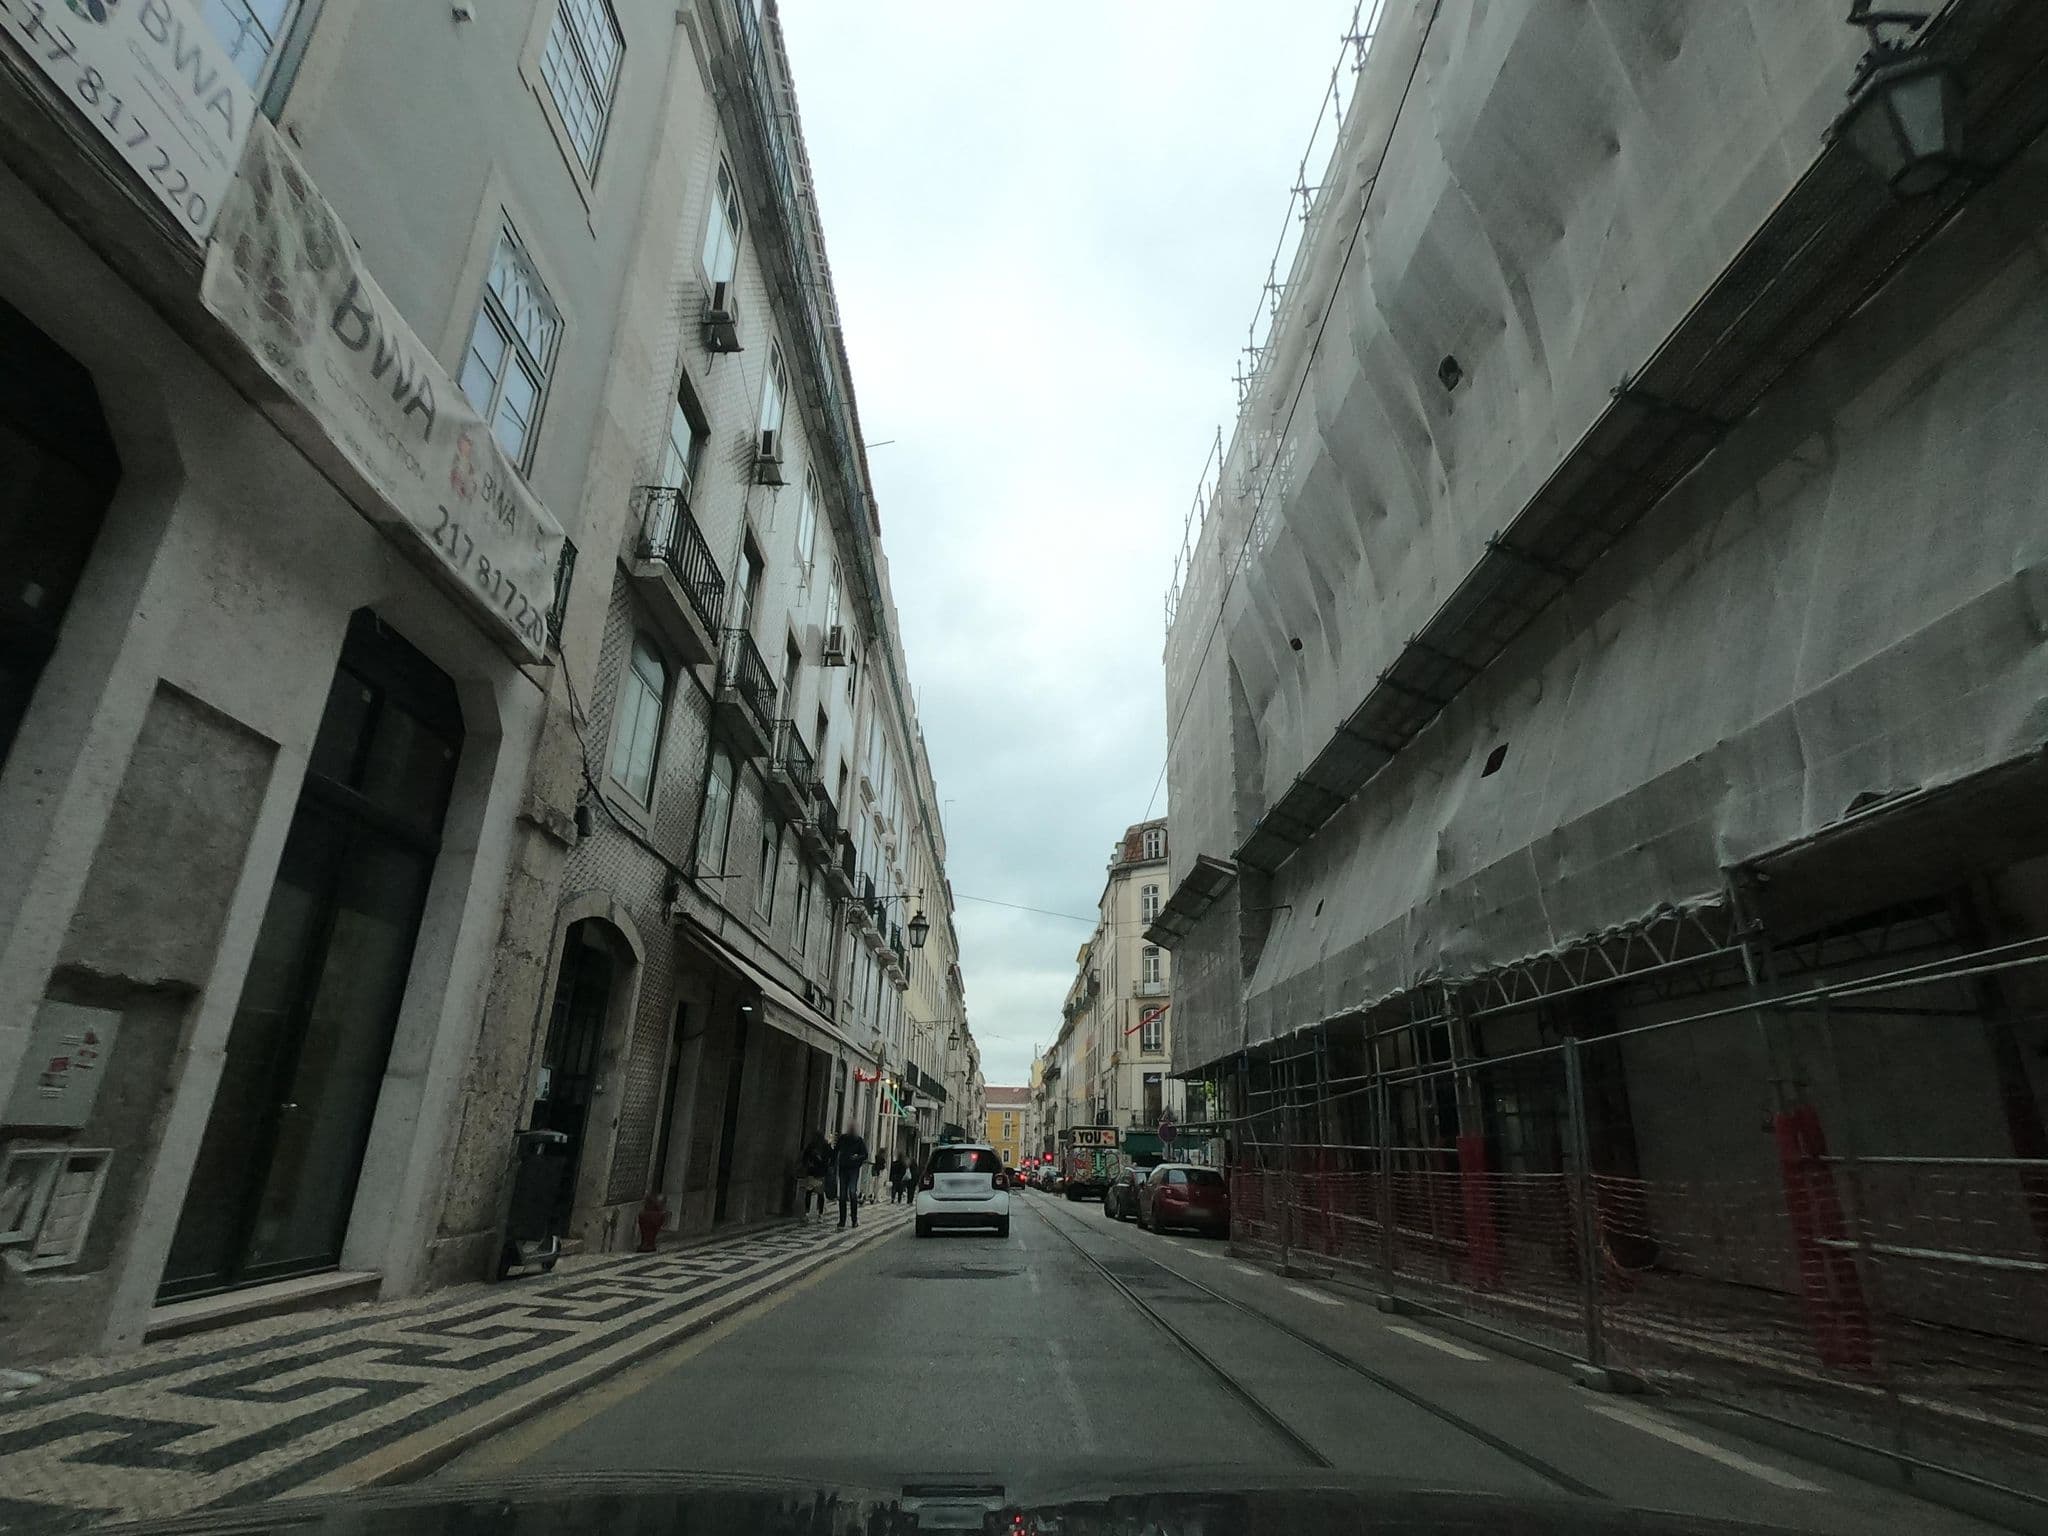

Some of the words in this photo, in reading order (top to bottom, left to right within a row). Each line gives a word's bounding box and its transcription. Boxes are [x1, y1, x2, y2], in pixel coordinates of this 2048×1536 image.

[138, 0, 234, 142] BWA
[330, 273, 436, 444] BWA
[481, 472, 516, 536] BWA
